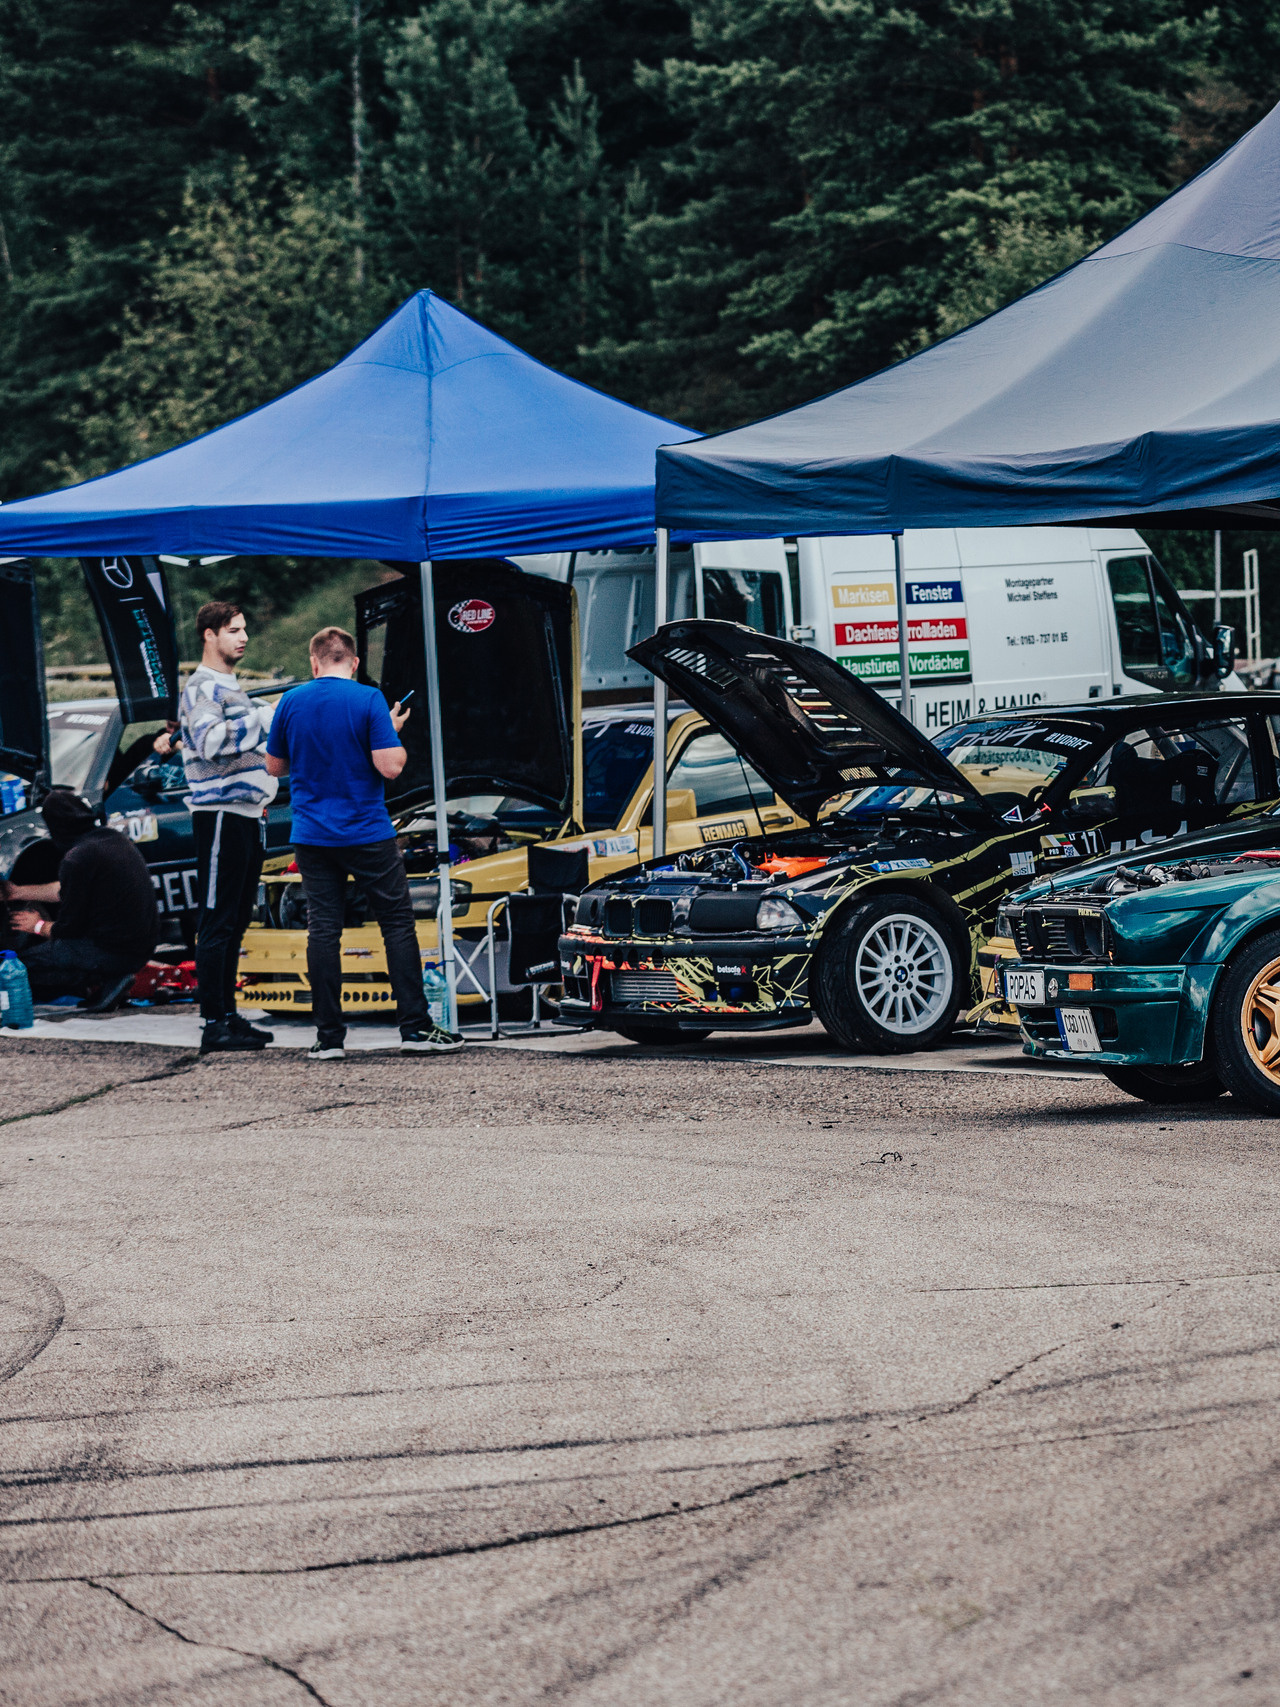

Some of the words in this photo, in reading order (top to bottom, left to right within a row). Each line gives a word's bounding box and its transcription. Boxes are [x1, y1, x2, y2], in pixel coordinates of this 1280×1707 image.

[837, 585, 891, 605] Markisen
[910, 585, 954, 602] Fenster
[842, 656, 900, 676] Haustüren
[909, 654, 965, 673] Vordächer
[926, 698, 971, 729] HEIM
[1043, 731, 1094, 751] #LVDRIFT
[702, 822, 747, 842] RENMAG
[1080, 830, 1098, 855] 17
[1009, 974, 1038, 1000] POPAS
